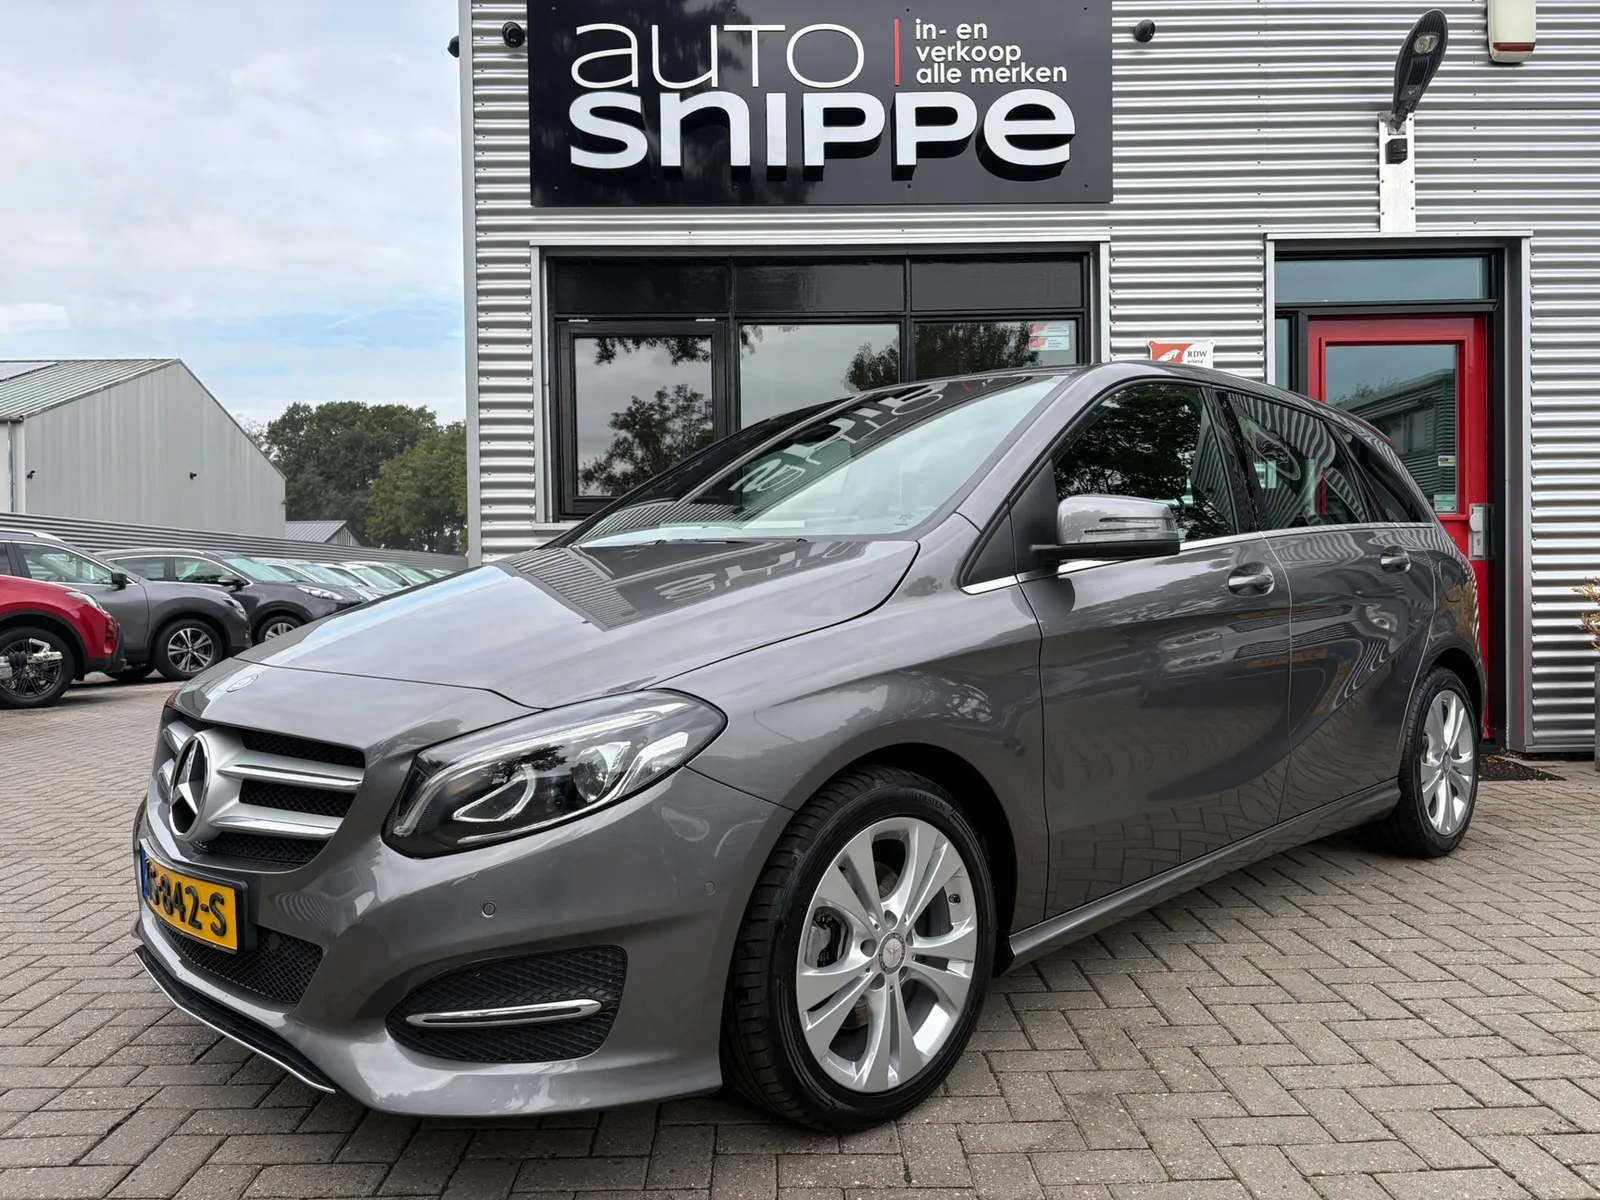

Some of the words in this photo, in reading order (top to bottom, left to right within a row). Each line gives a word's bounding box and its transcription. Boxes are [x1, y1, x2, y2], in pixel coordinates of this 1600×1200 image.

[915, 18, 947, 40] in-
[956, 22, 988, 40] en
[915, 41, 1022, 66] verkoop
[916, 62, 962, 84] alle
[970, 62, 1067, 84] merken
